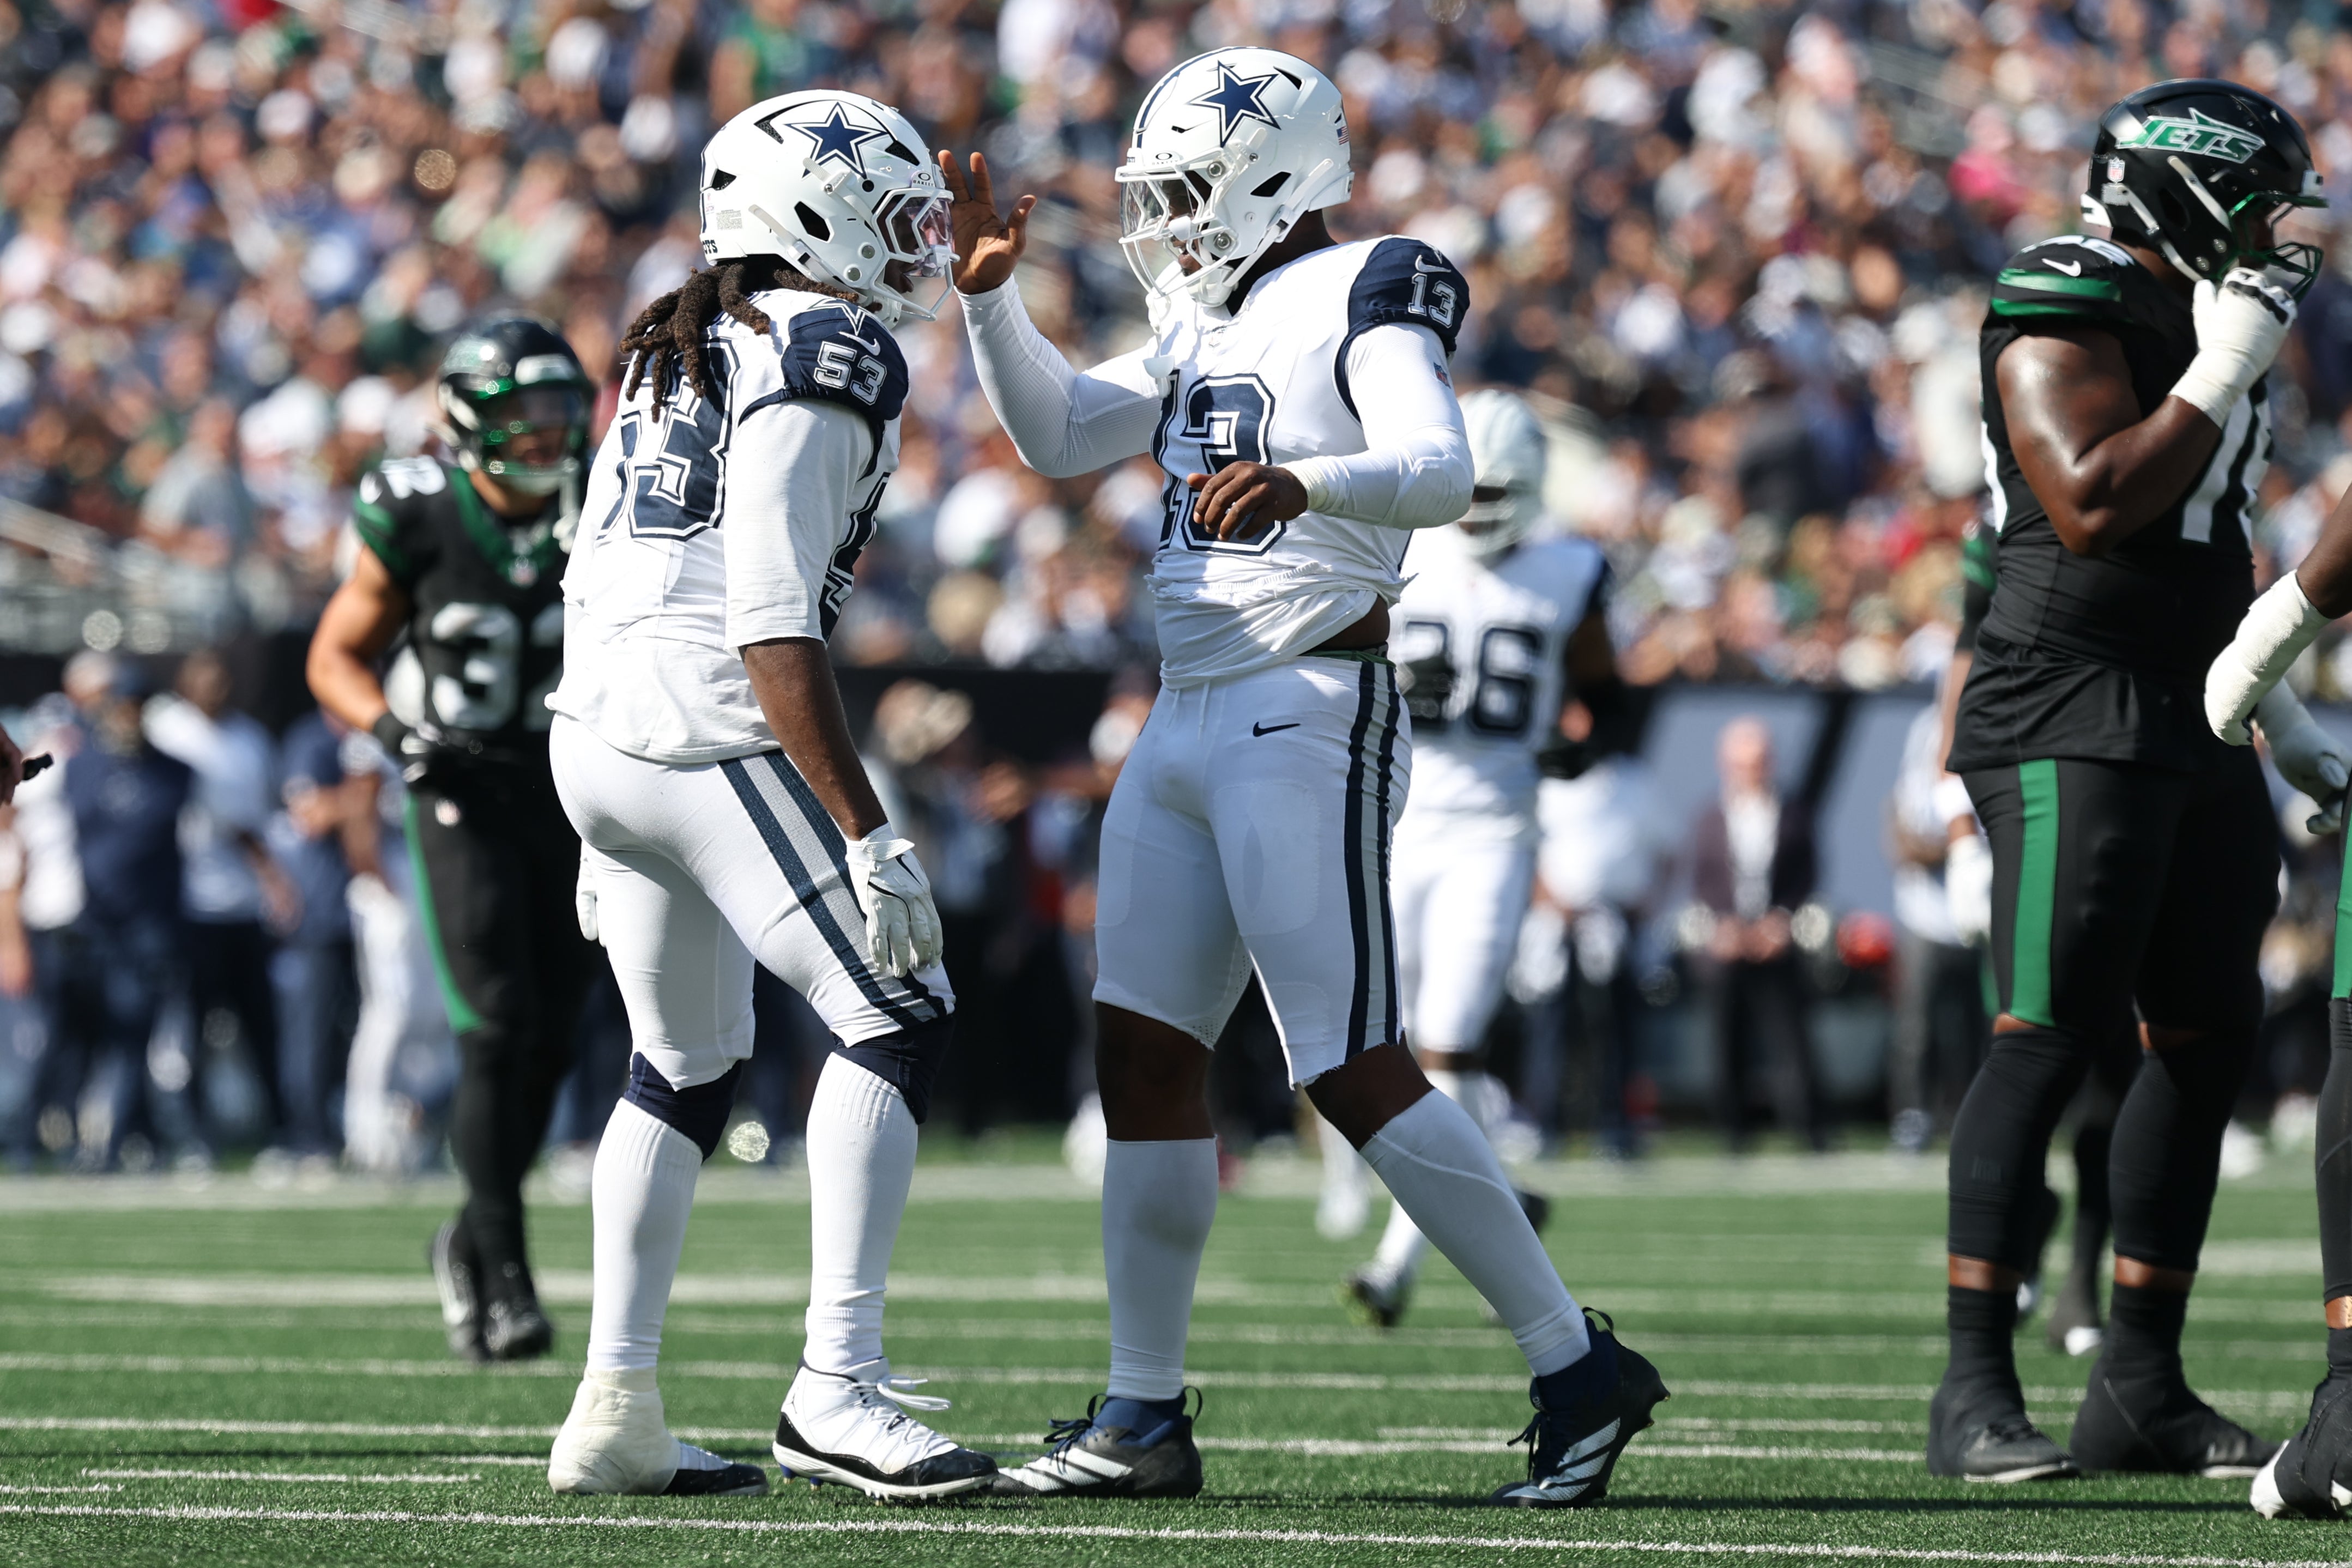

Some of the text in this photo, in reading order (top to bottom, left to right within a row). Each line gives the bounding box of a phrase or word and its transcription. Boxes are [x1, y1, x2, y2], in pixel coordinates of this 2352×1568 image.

[2115, 107, 2266, 164] JETS
[1407, 273, 1458, 329] 13
[814, 341, 887, 405] 53
